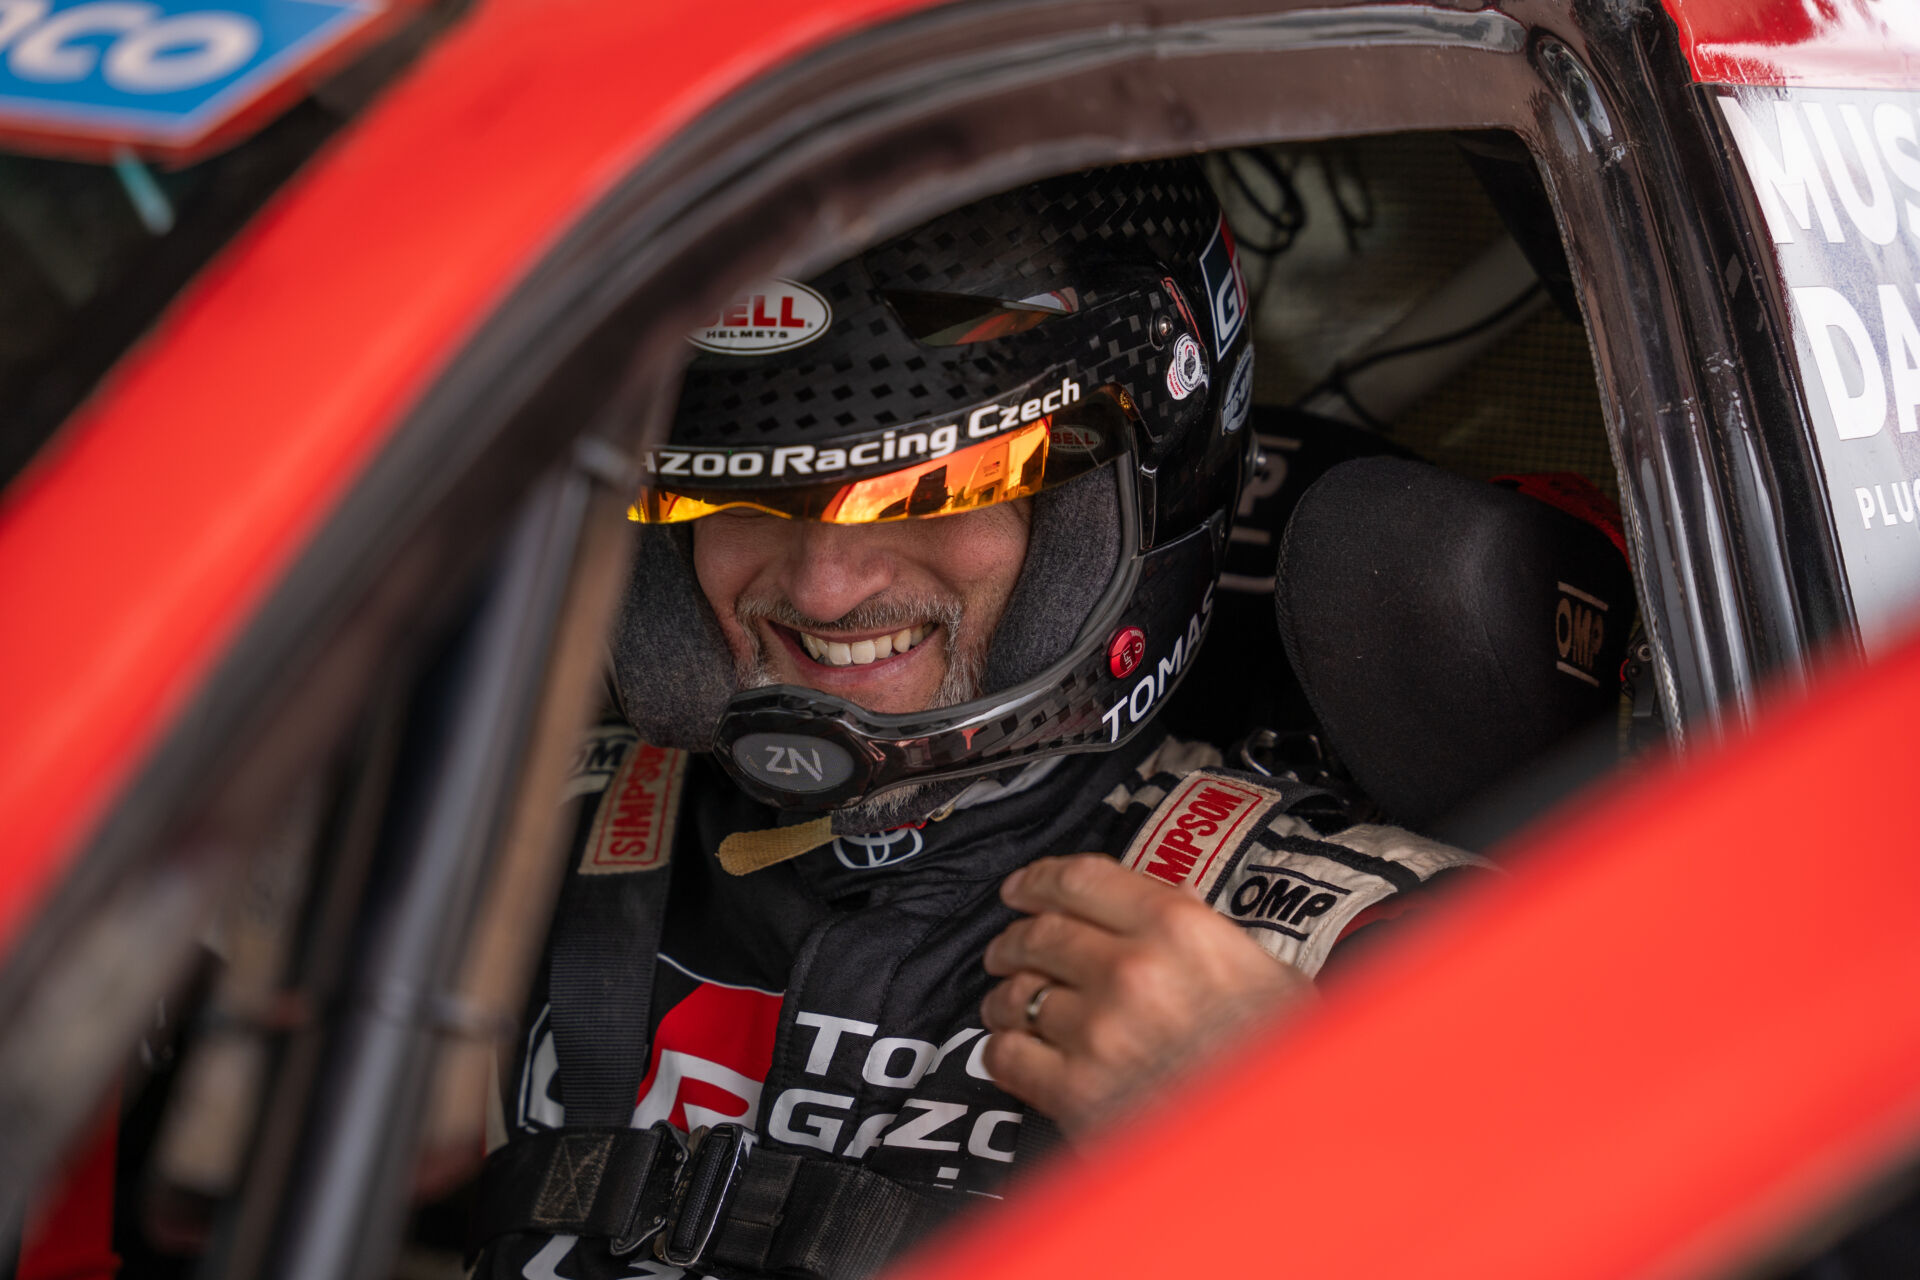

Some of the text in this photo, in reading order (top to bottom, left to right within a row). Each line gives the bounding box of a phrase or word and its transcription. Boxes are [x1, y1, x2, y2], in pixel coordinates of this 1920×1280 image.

[706, 330, 788, 338] HELMETS
[770, 424, 958, 477] Racing
[967, 377, 1080, 438] Czech
[1051, 432, 1095, 445] BELL
[1556, 598, 1604, 671] OMP
[1230, 875, 1338, 926] OMP
